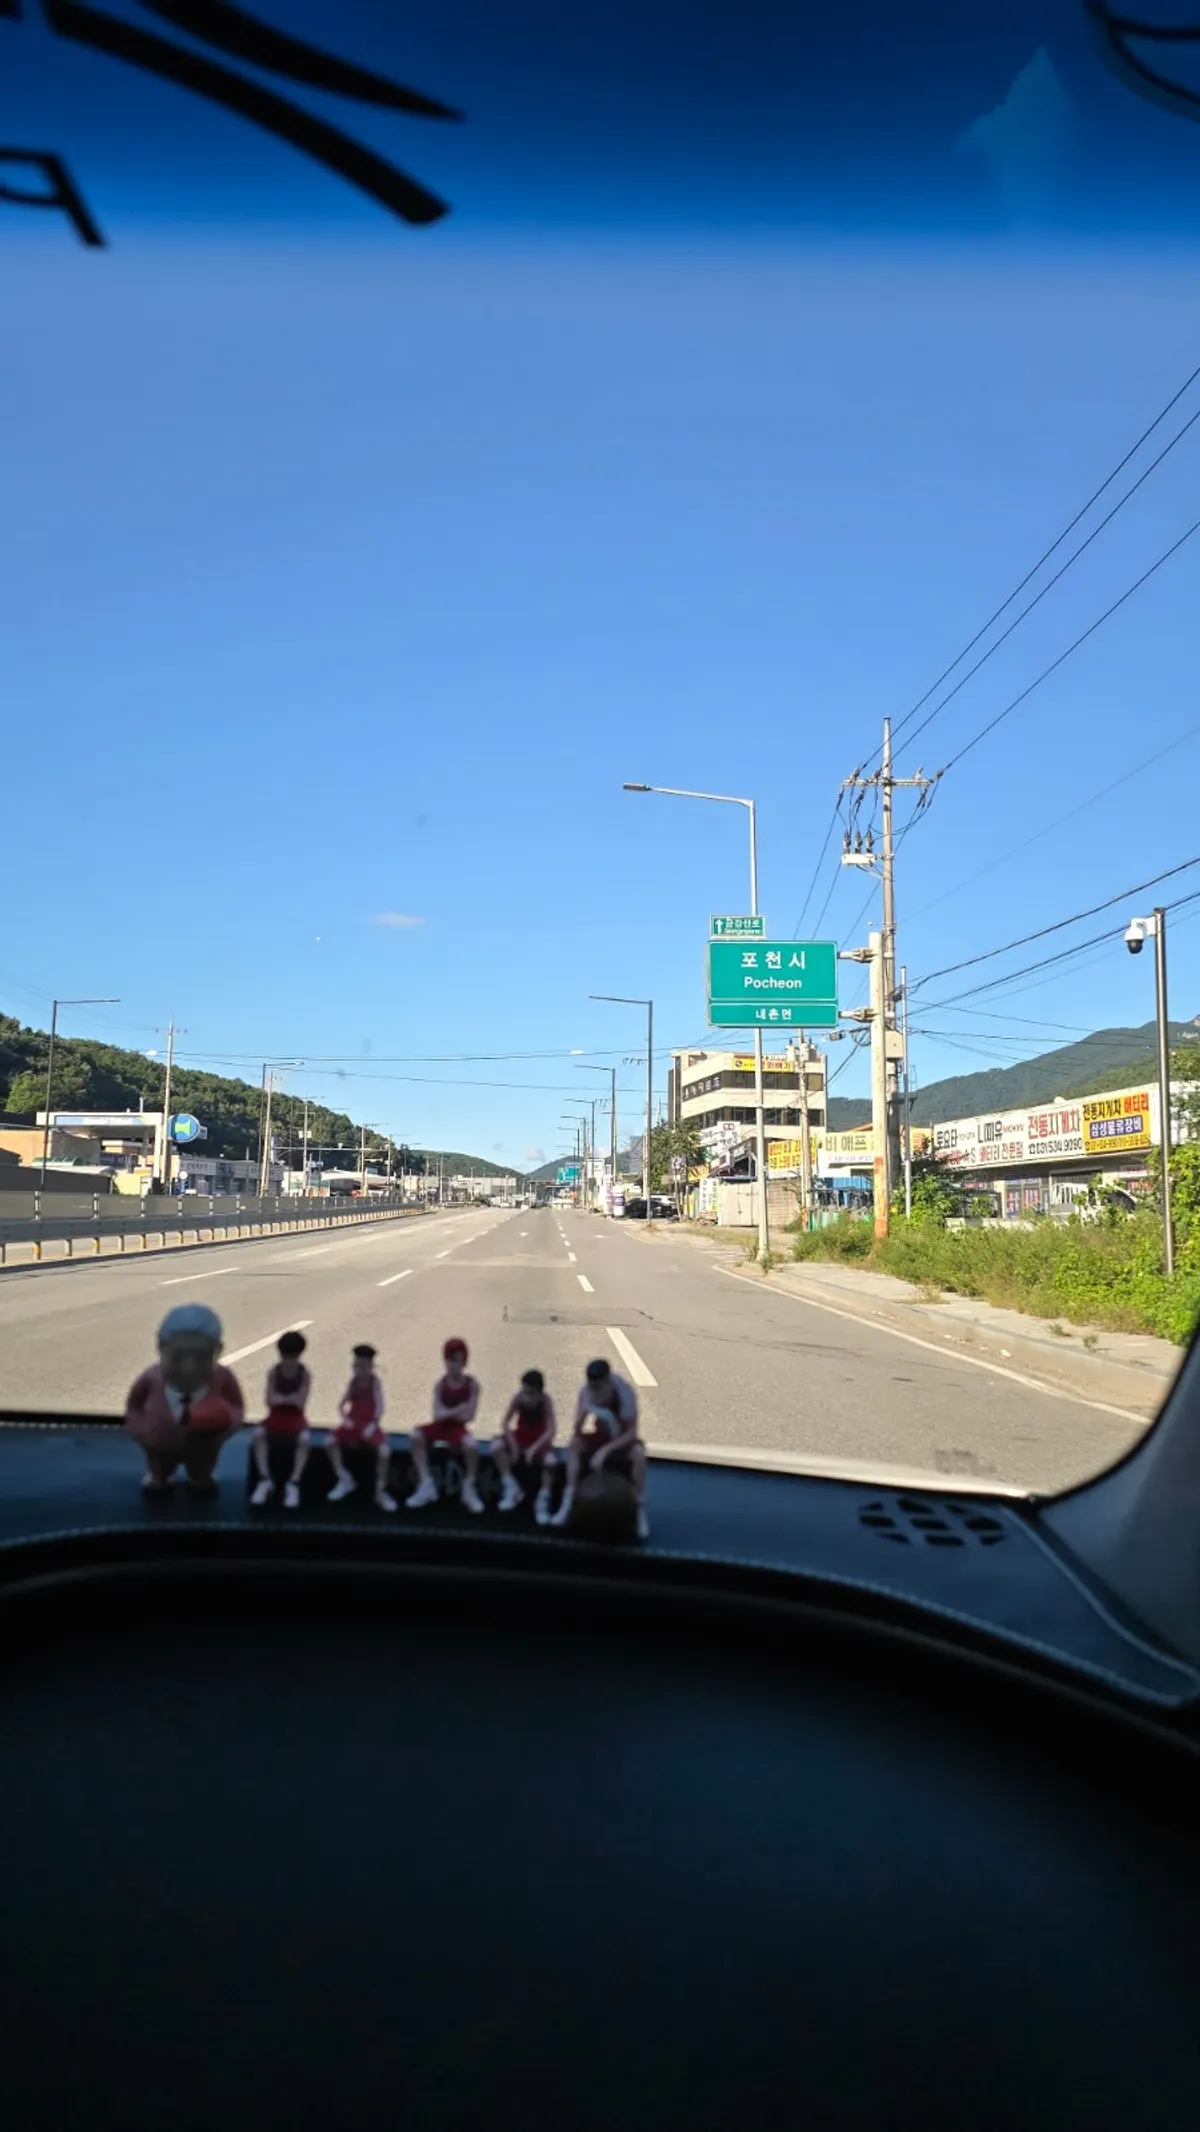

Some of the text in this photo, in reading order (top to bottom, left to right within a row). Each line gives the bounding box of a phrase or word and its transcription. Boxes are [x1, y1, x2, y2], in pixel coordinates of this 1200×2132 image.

[741, 951, 806, 970] 포천시
[744, 976, 802, 989] Pocheon
[756, 1008, 792, 1020] 내촌면
[937, 1128, 958, 1148] 토요타
